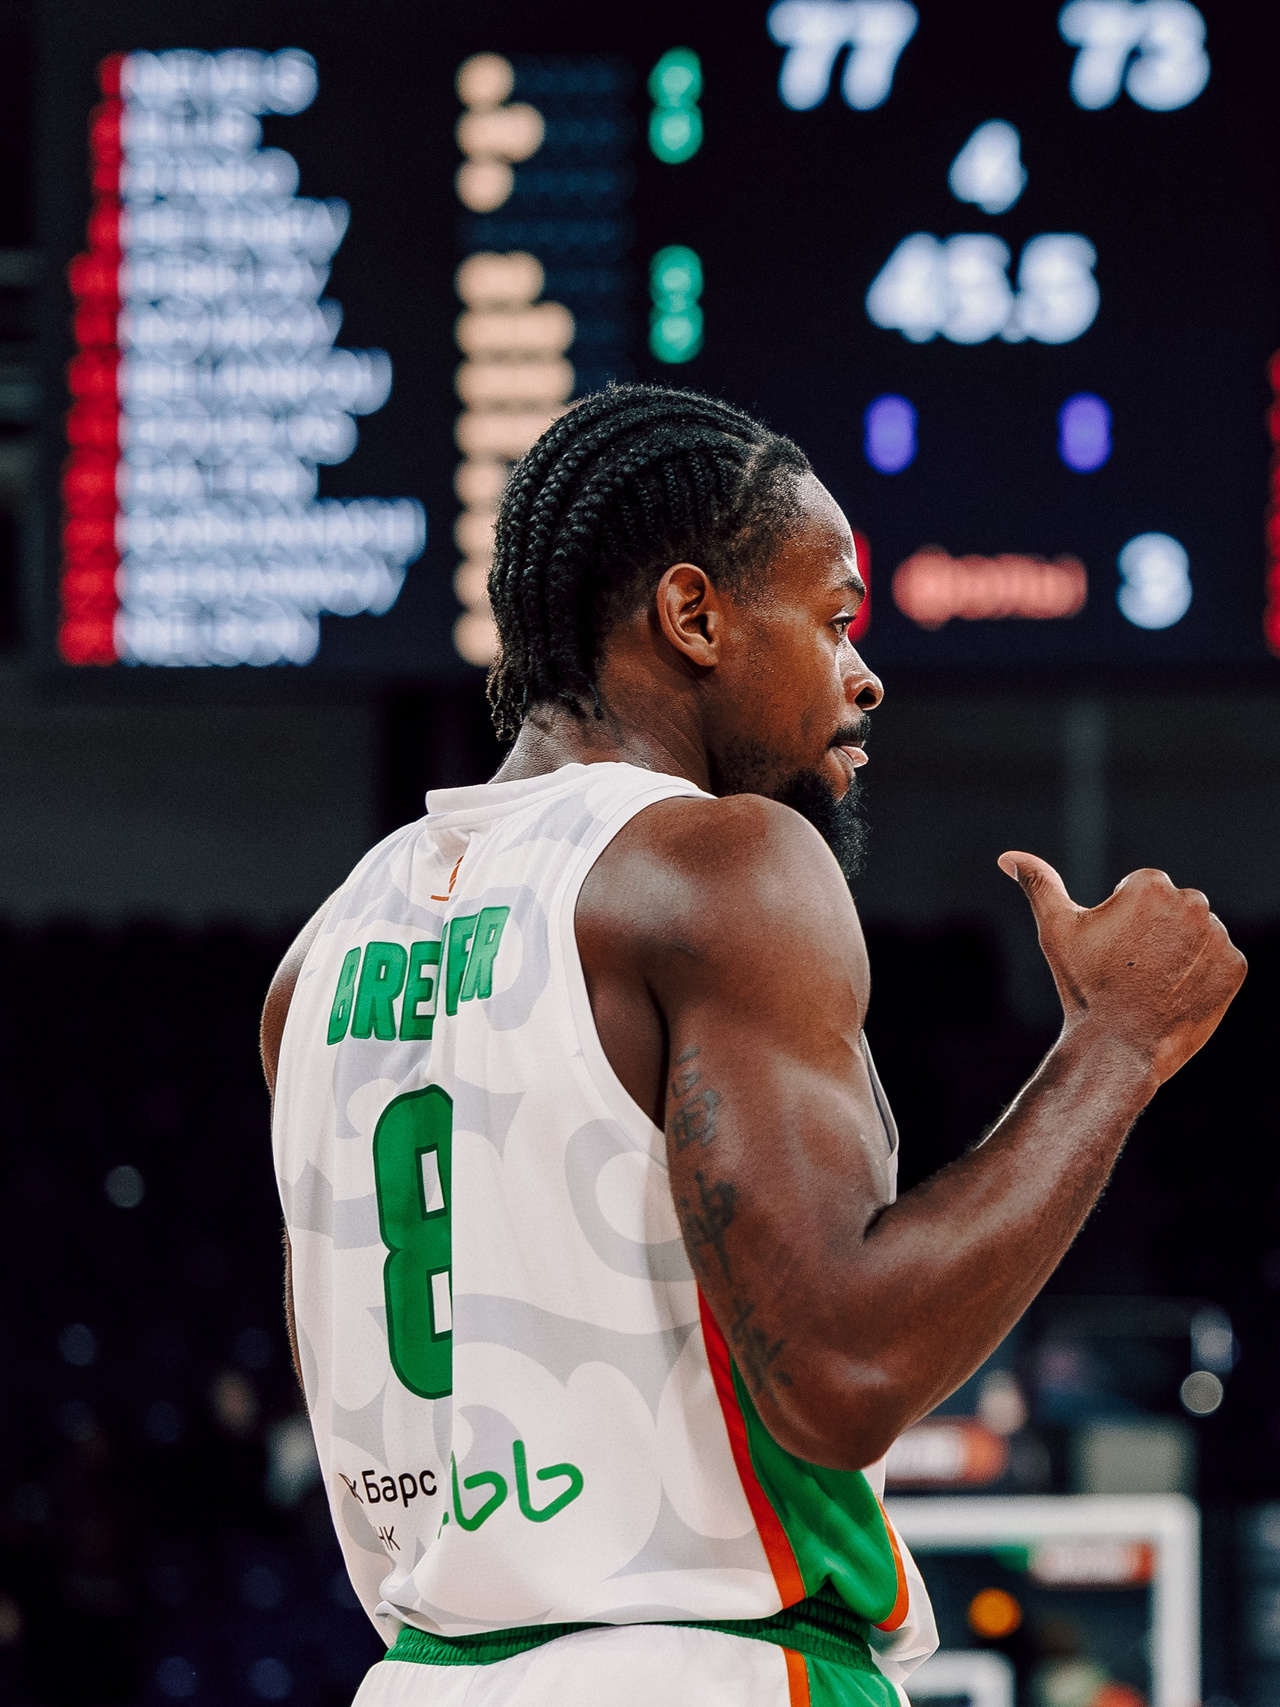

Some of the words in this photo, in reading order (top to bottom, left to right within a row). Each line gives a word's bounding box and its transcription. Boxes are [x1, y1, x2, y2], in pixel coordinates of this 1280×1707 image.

[769, 0, 917, 109] 77
[1060, 0, 1209, 110] 73
[950, 121, 1024, 212] 4
[372, 1083, 453, 1400] 8
[361, 1468, 437, 1508] Барс
